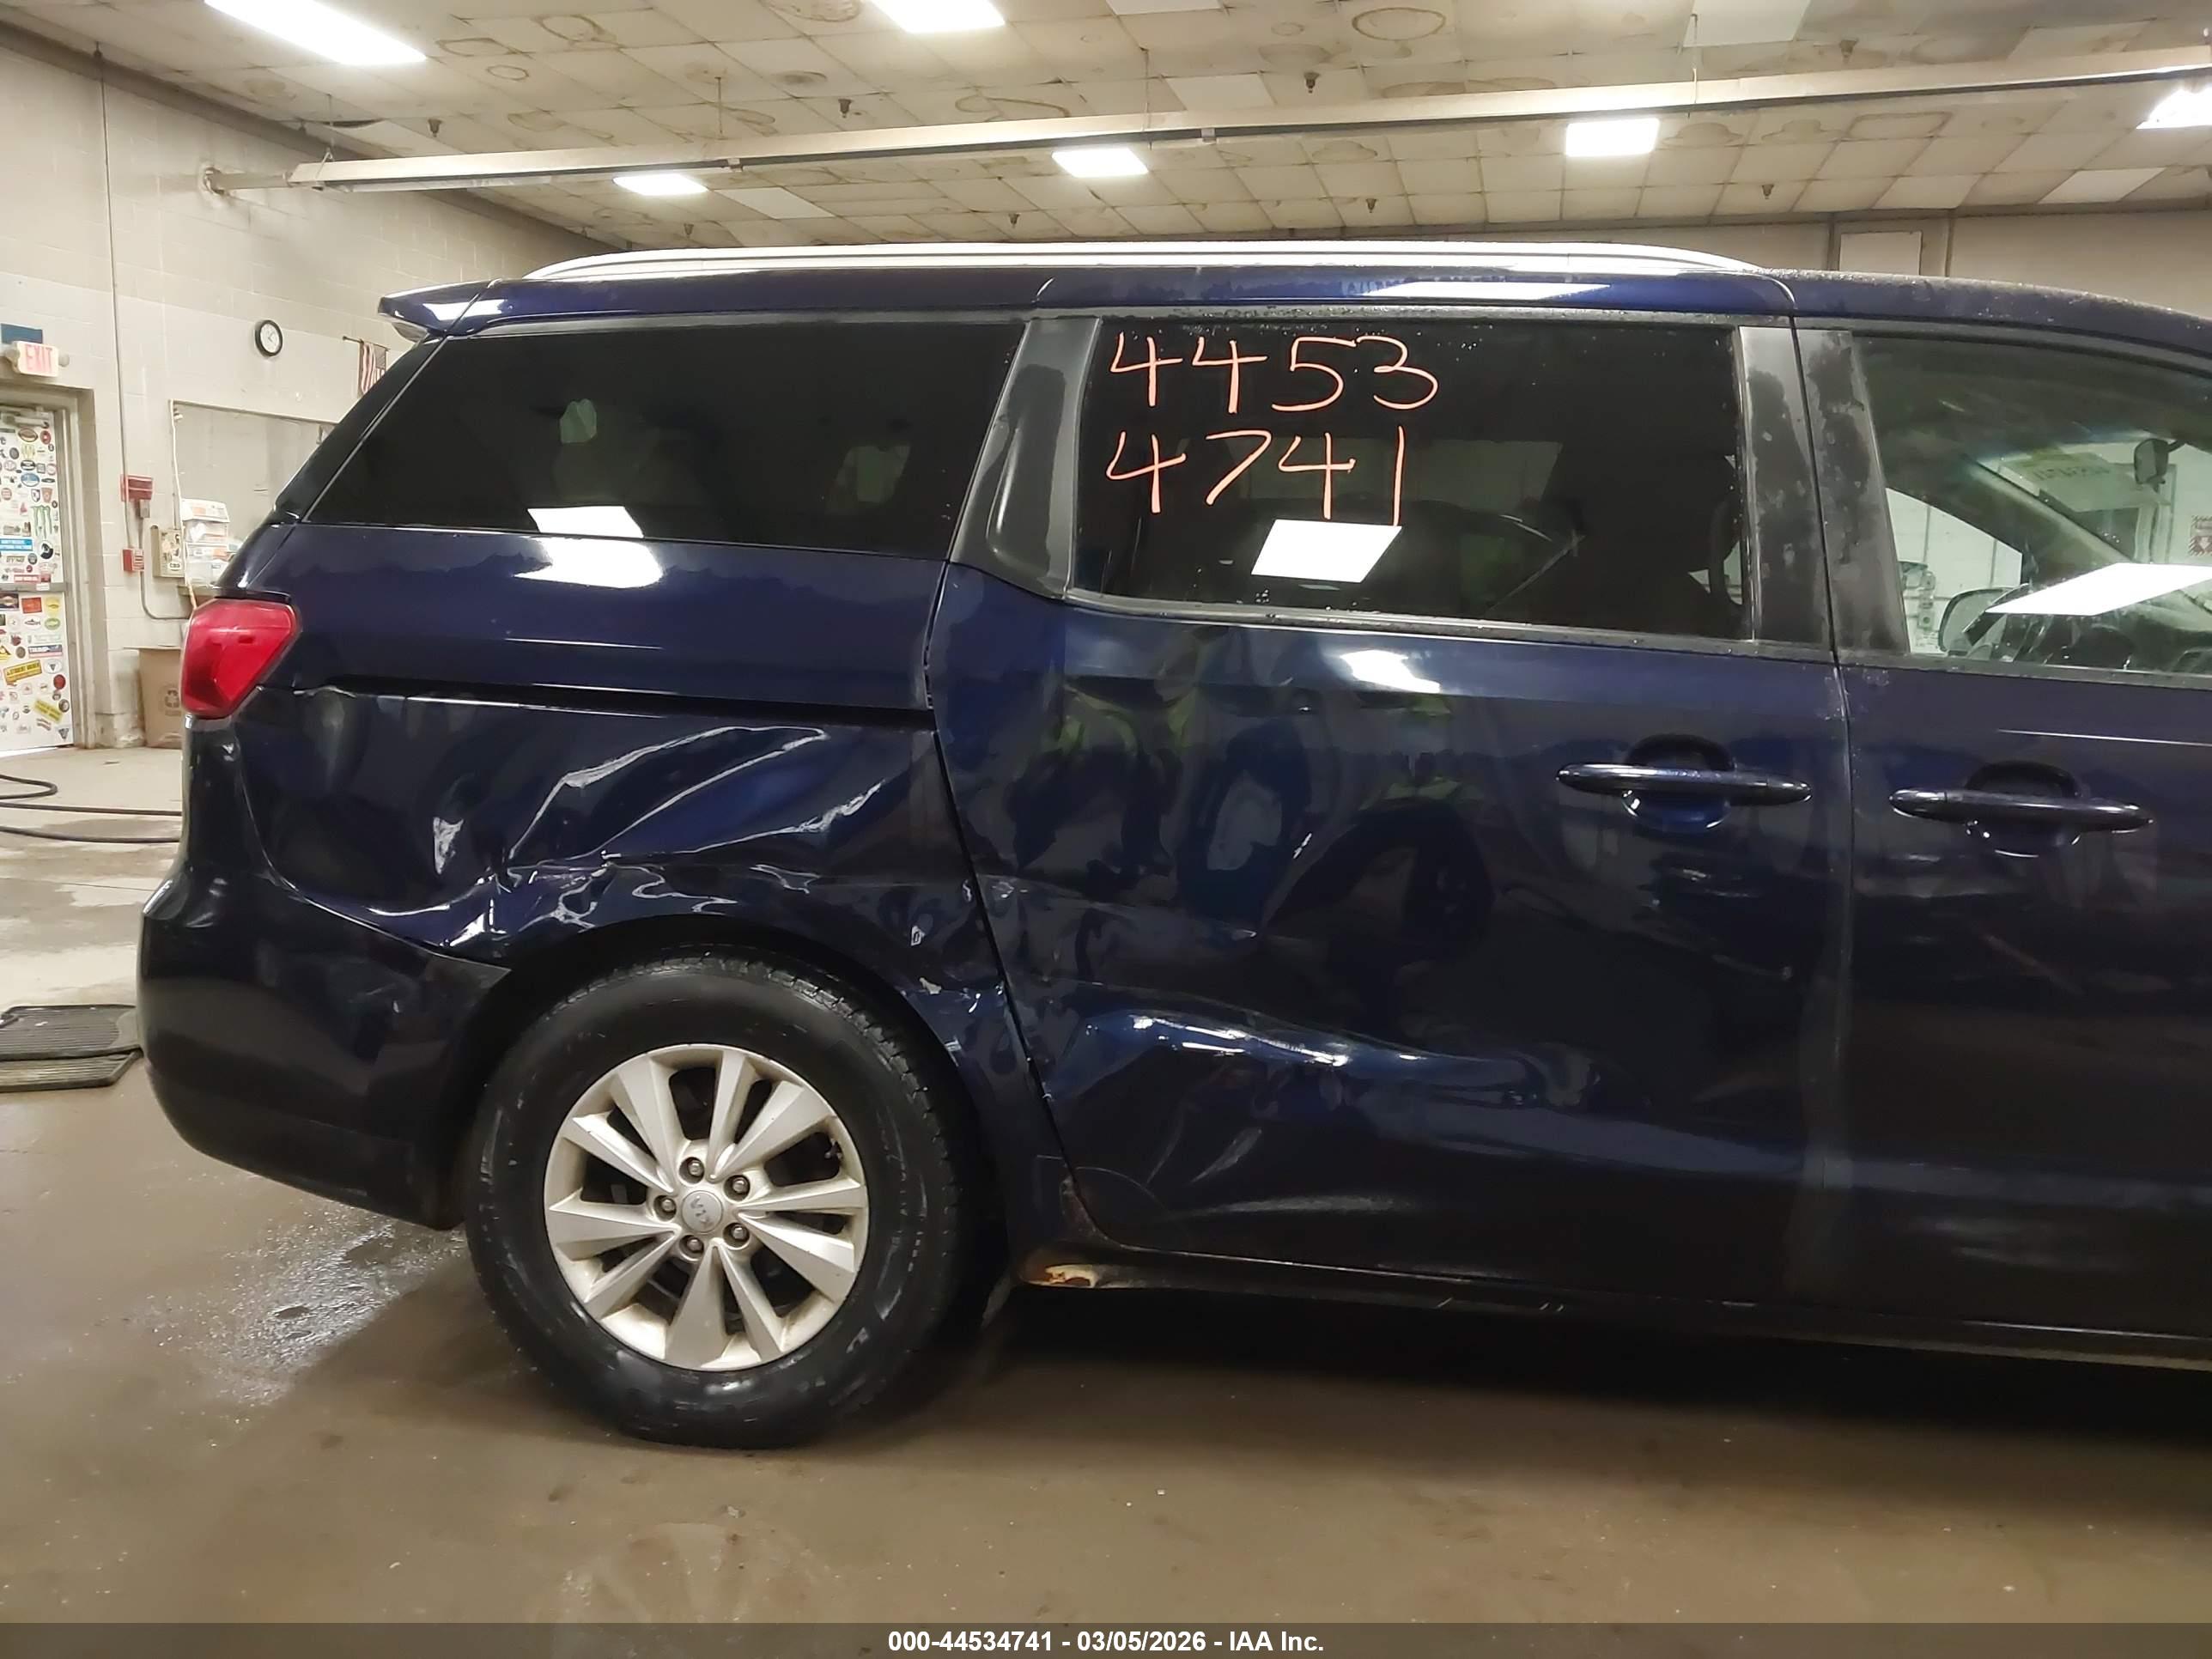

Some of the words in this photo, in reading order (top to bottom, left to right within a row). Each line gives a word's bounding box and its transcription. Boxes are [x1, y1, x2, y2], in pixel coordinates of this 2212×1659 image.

[25, 343, 53, 373] EXIT
[1109, 331, 1438, 414] 4453
[1106, 426, 1406, 526] 4741
